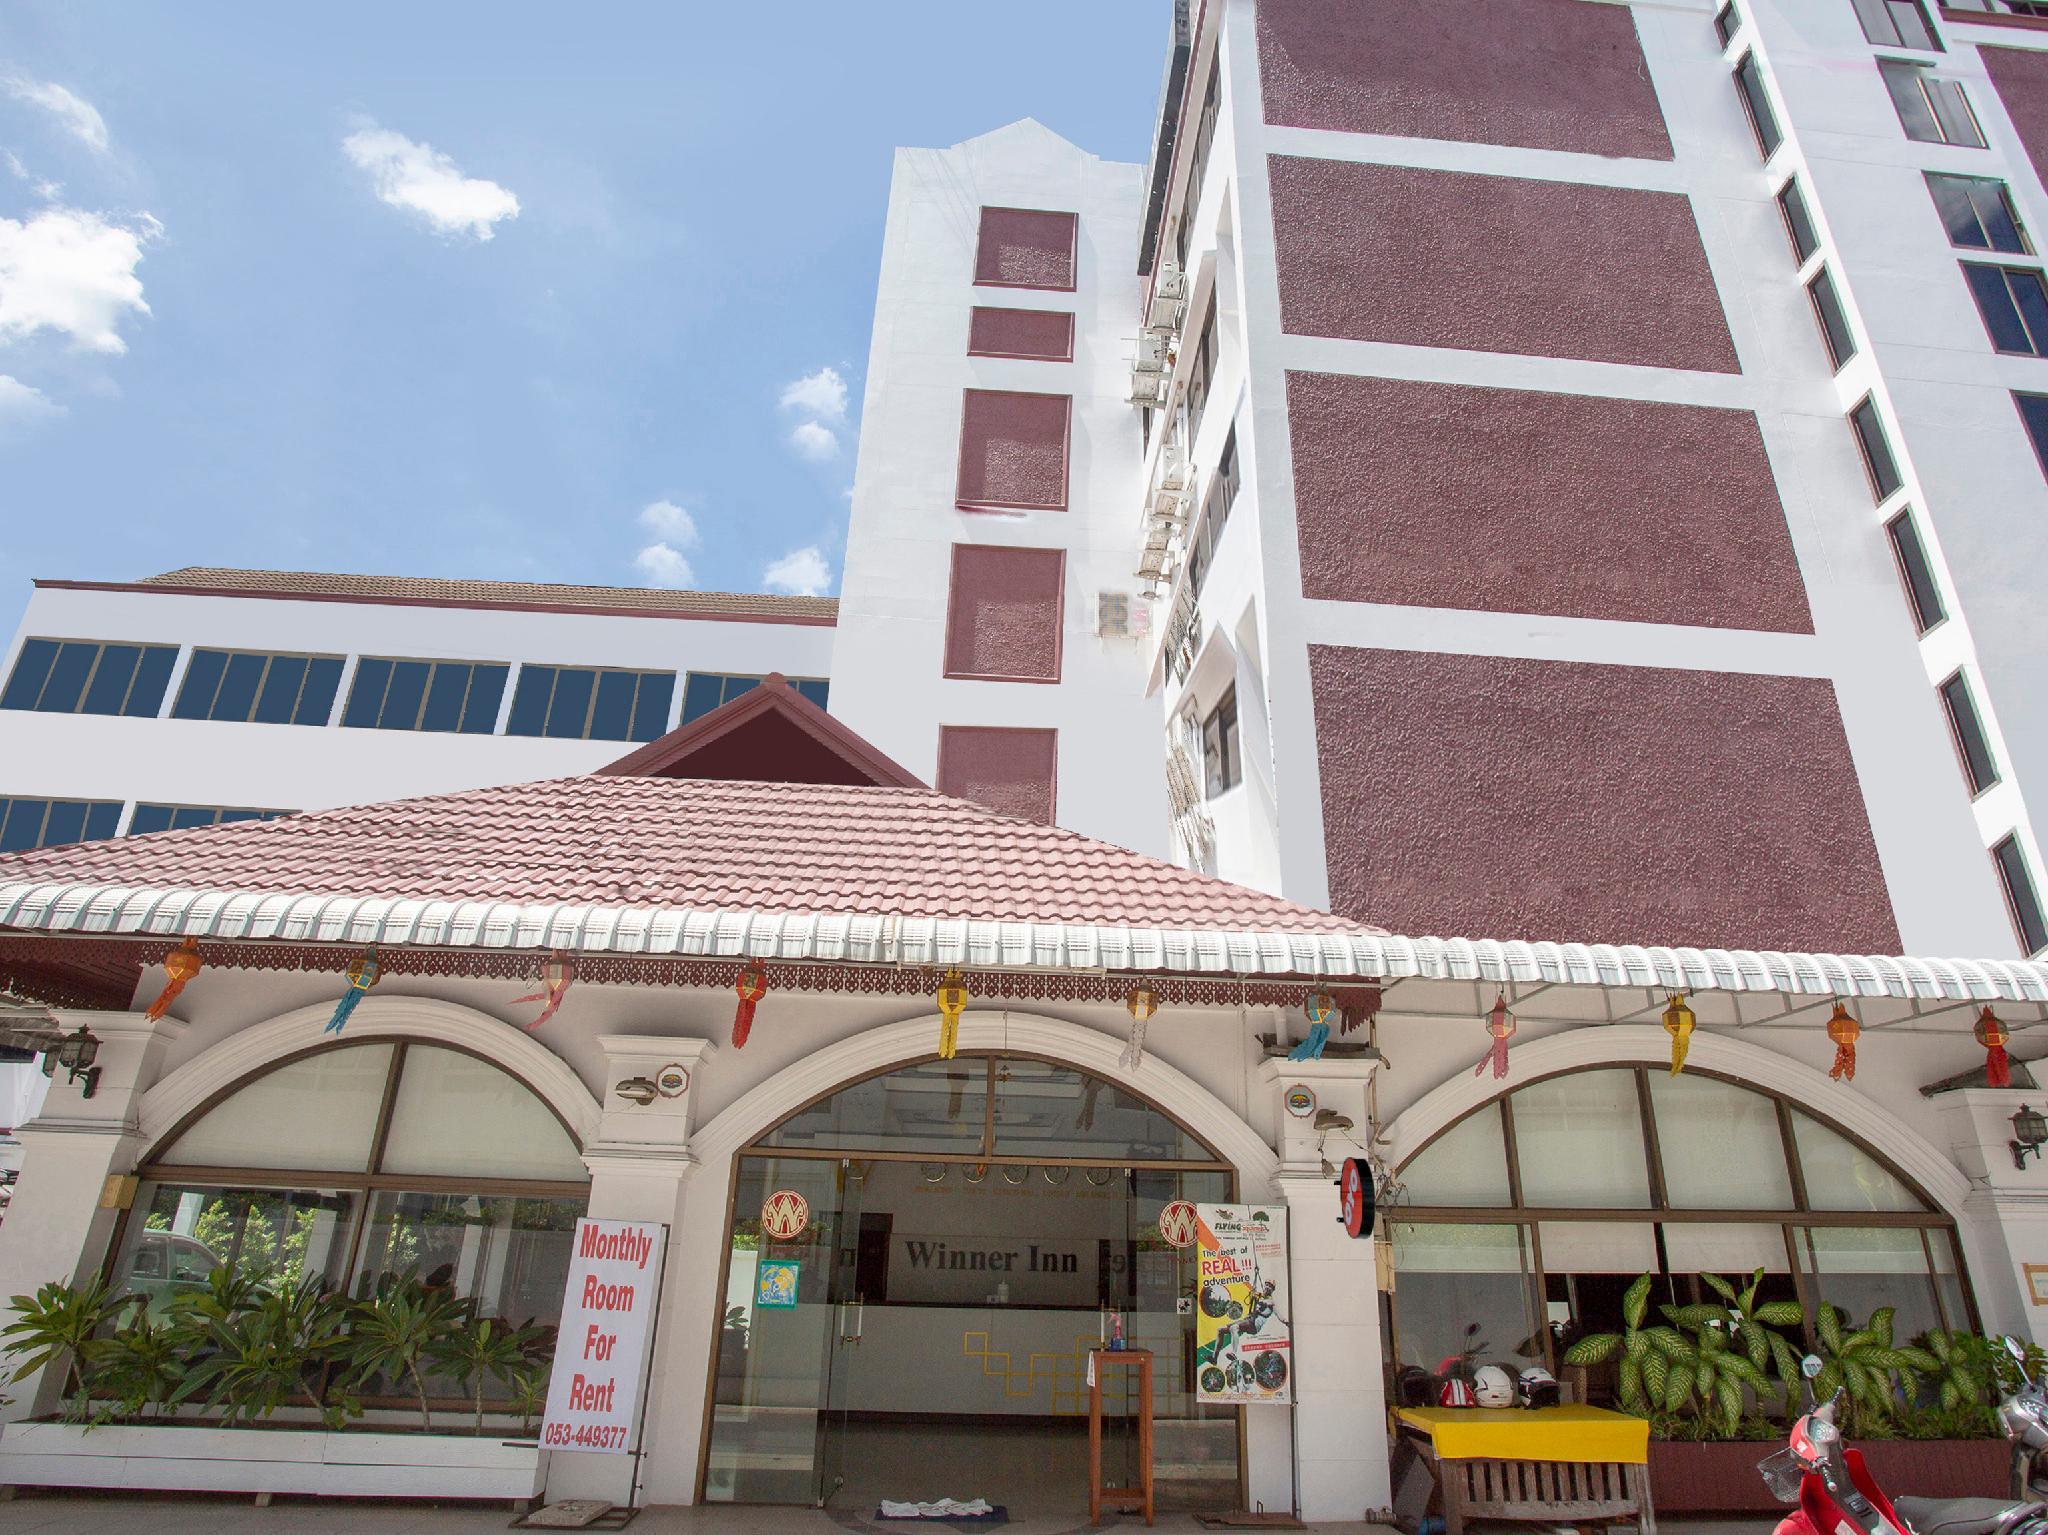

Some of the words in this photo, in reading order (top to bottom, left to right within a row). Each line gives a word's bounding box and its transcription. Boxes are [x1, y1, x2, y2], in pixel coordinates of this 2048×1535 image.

[1344, 1168, 1358, 1225] OYO
[580, 1224, 652, 1269] Monthly
[905, 1241, 1018, 1271] Winner
[1027, 1245, 1077, 1273] Inn
[1202, 1249, 1217, 1257] The
[1221, 1247, 1236, 1255] best
[1240, 1246, 1248, 1254] of
[582, 1275, 634, 1311] Room
[1203, 1275, 1250, 1287] adventure
[584, 1324, 616, 1361] For
[569, 1373, 615, 1412] Rent
[545, 1422, 627, 1449] 053-449377
